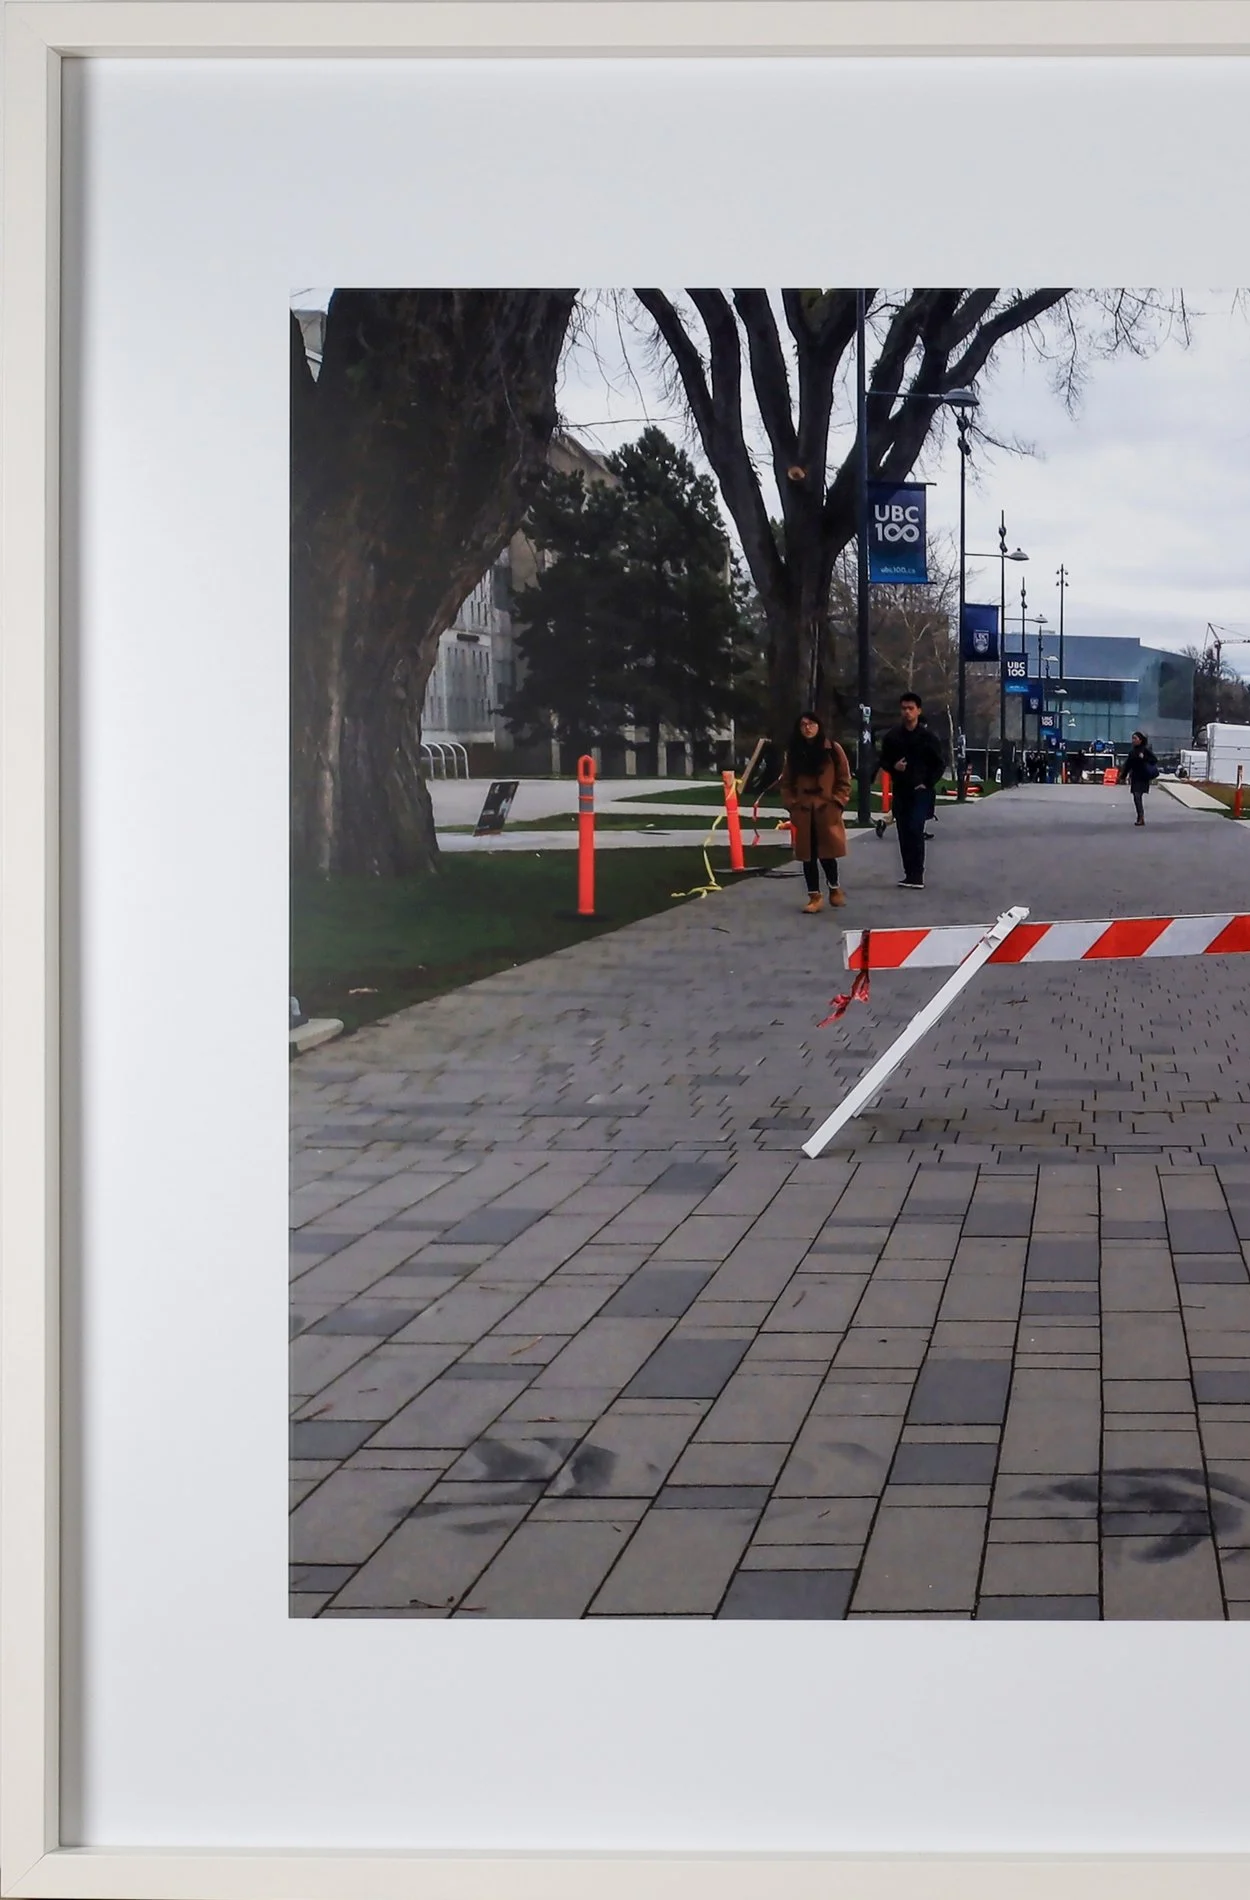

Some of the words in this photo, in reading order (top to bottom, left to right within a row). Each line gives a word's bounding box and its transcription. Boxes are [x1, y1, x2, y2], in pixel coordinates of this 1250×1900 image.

[874, 504, 919, 523] UBC
[874, 523, 920, 542] 100
[1007, 661, 1025, 669] UBC
[1007, 669, 1025, 677] 100
